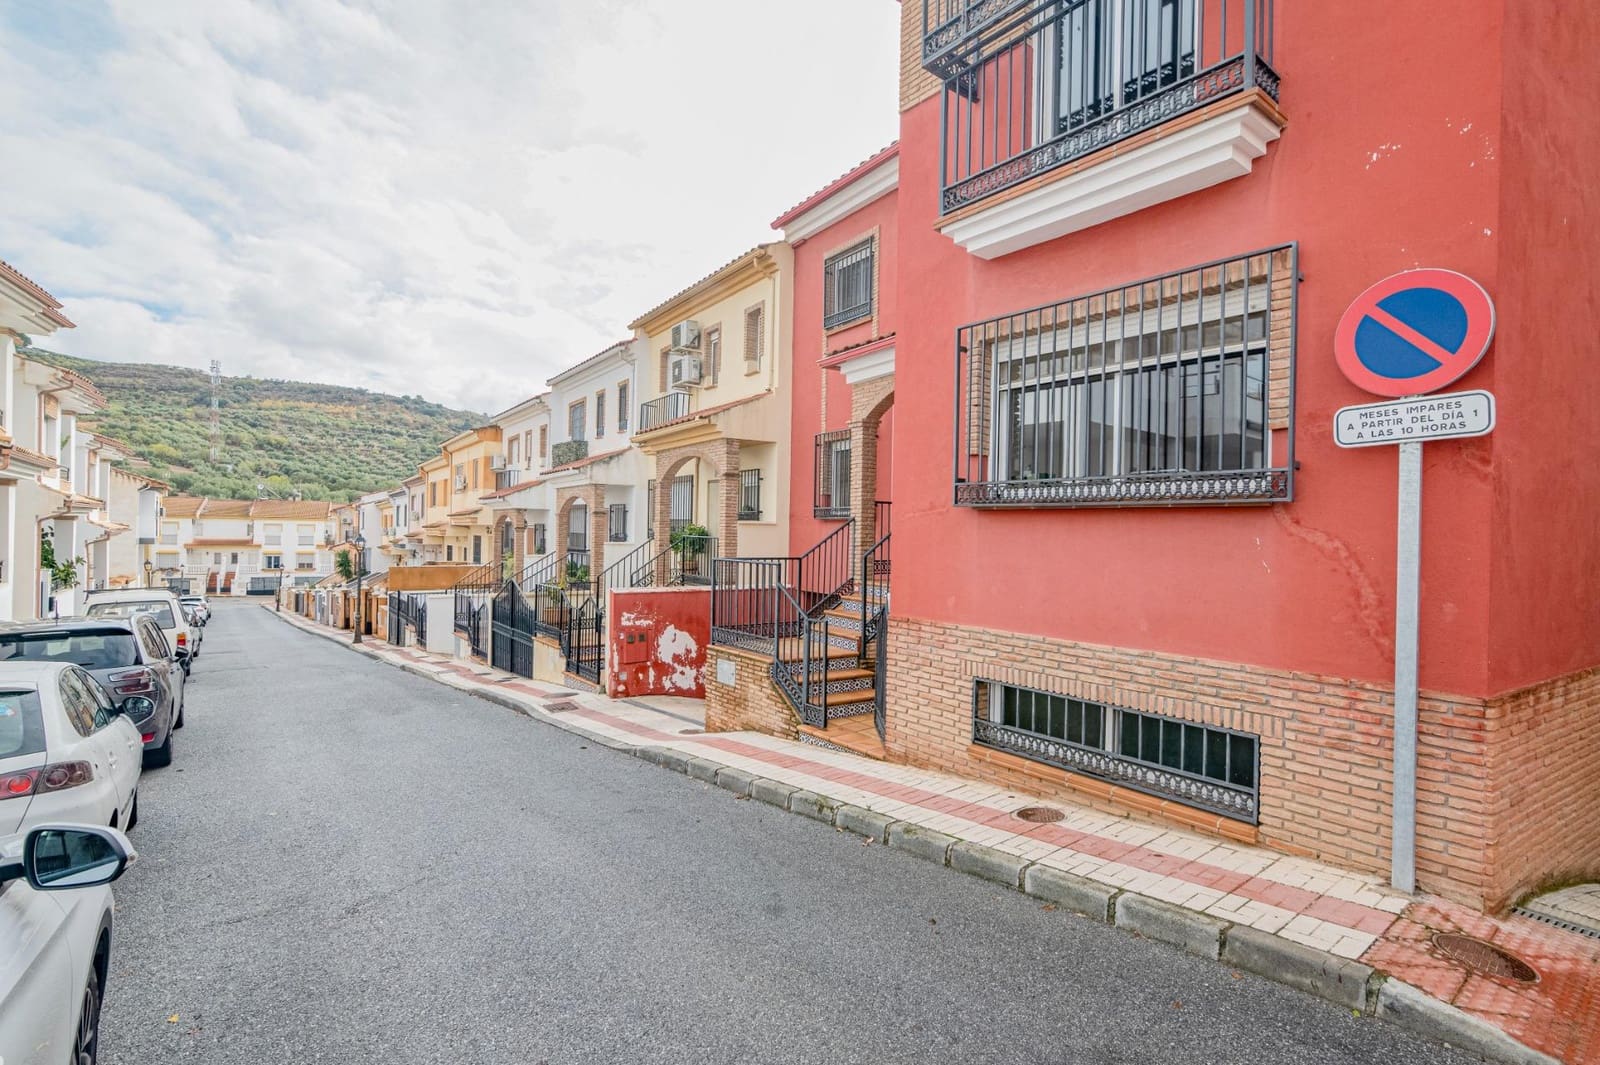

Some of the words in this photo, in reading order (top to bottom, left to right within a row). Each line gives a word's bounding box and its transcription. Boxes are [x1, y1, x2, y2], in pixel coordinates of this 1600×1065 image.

[1347, 423, 1354, 431] A
[1361, 418, 1403, 429] PARTIR
[1411, 414, 1434, 424] DEL
[1442, 410, 1464, 421] DÍA
[1473, 409, 1478, 417] 1
[1359, 408, 1399, 420] MESES
[1406, 401, 1462, 414] IMPARES
[1371, 429, 1394, 438] LAS
[1402, 427, 1414, 435] 10
[1421, 421, 1467, 432] HORAS
